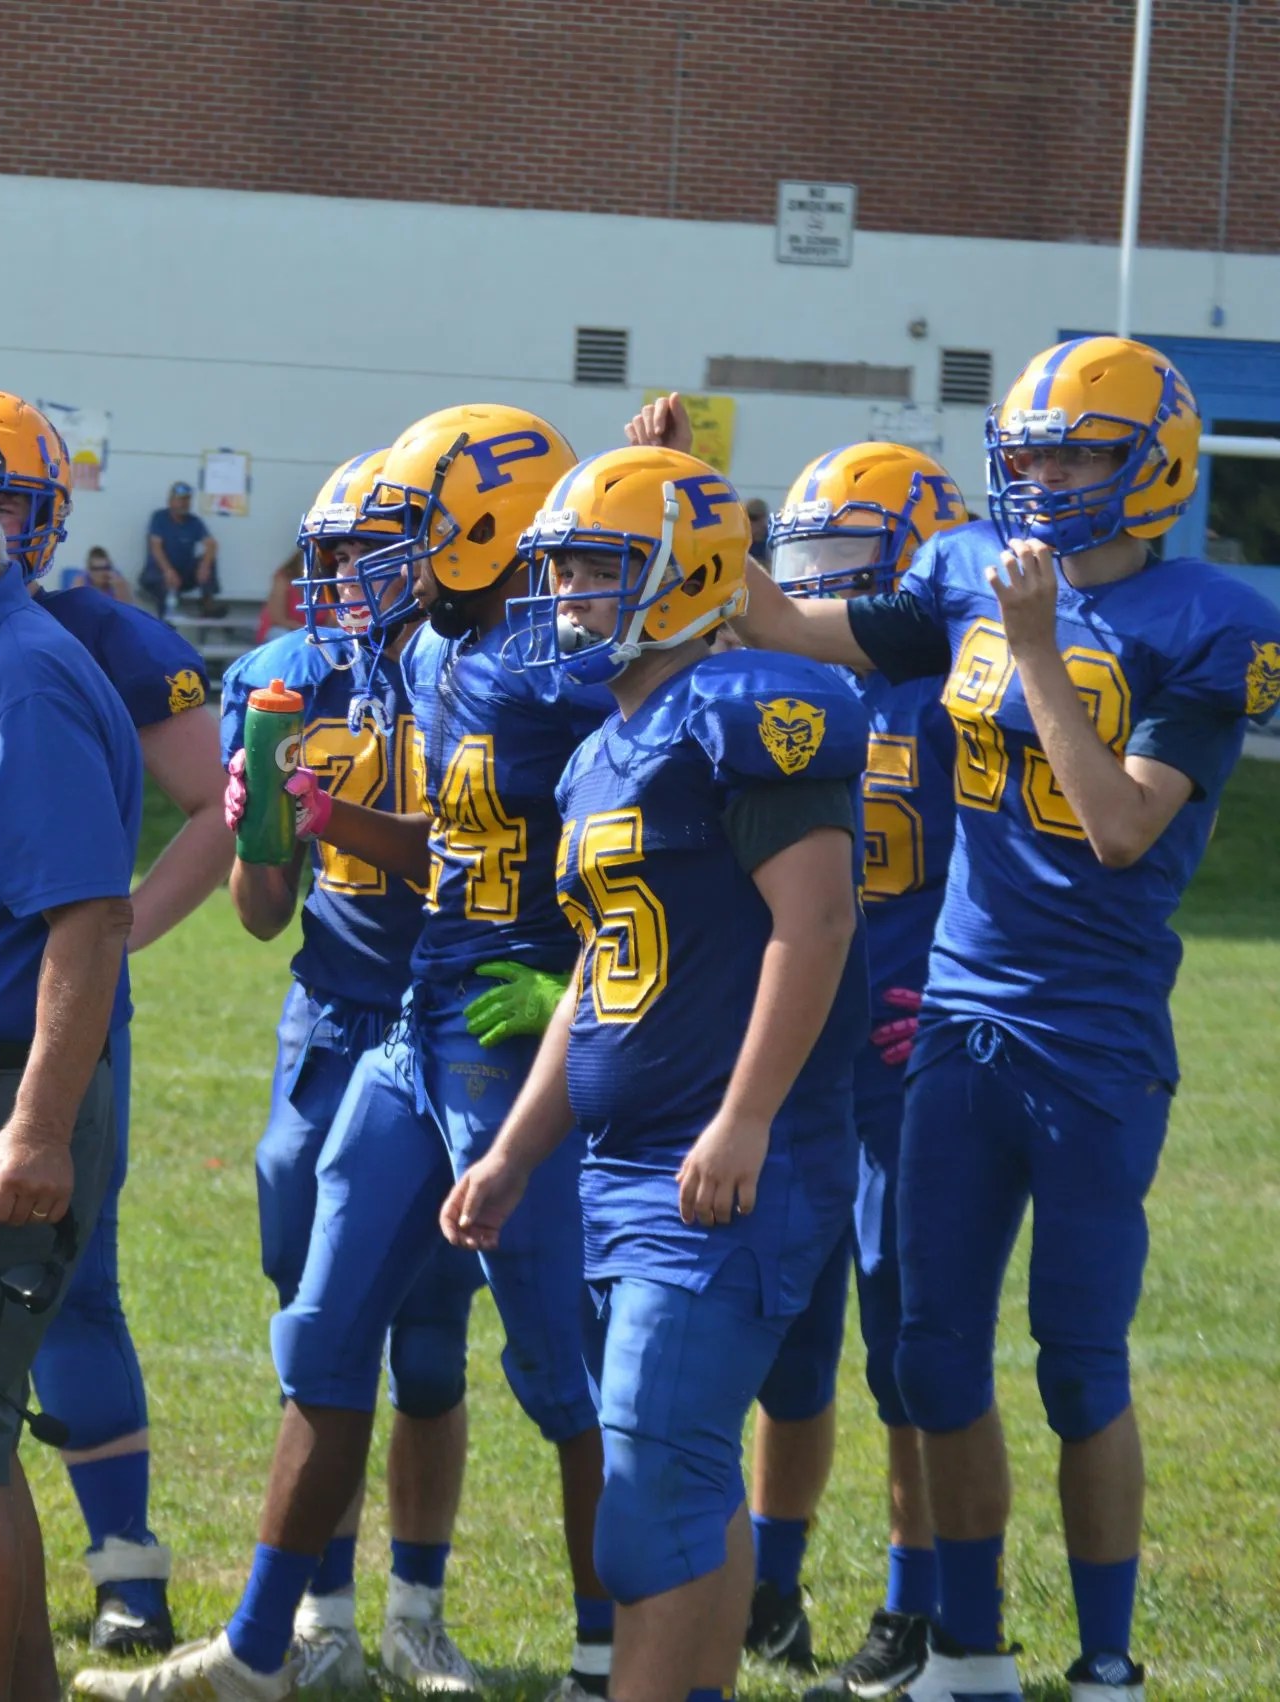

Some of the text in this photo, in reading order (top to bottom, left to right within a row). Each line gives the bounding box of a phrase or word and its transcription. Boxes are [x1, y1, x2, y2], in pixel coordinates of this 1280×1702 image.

[787, 200, 845, 213] SMOKING
[808, 187, 826, 199] NO
[462, 430, 550, 494] P
[673, 474, 738, 530] P
